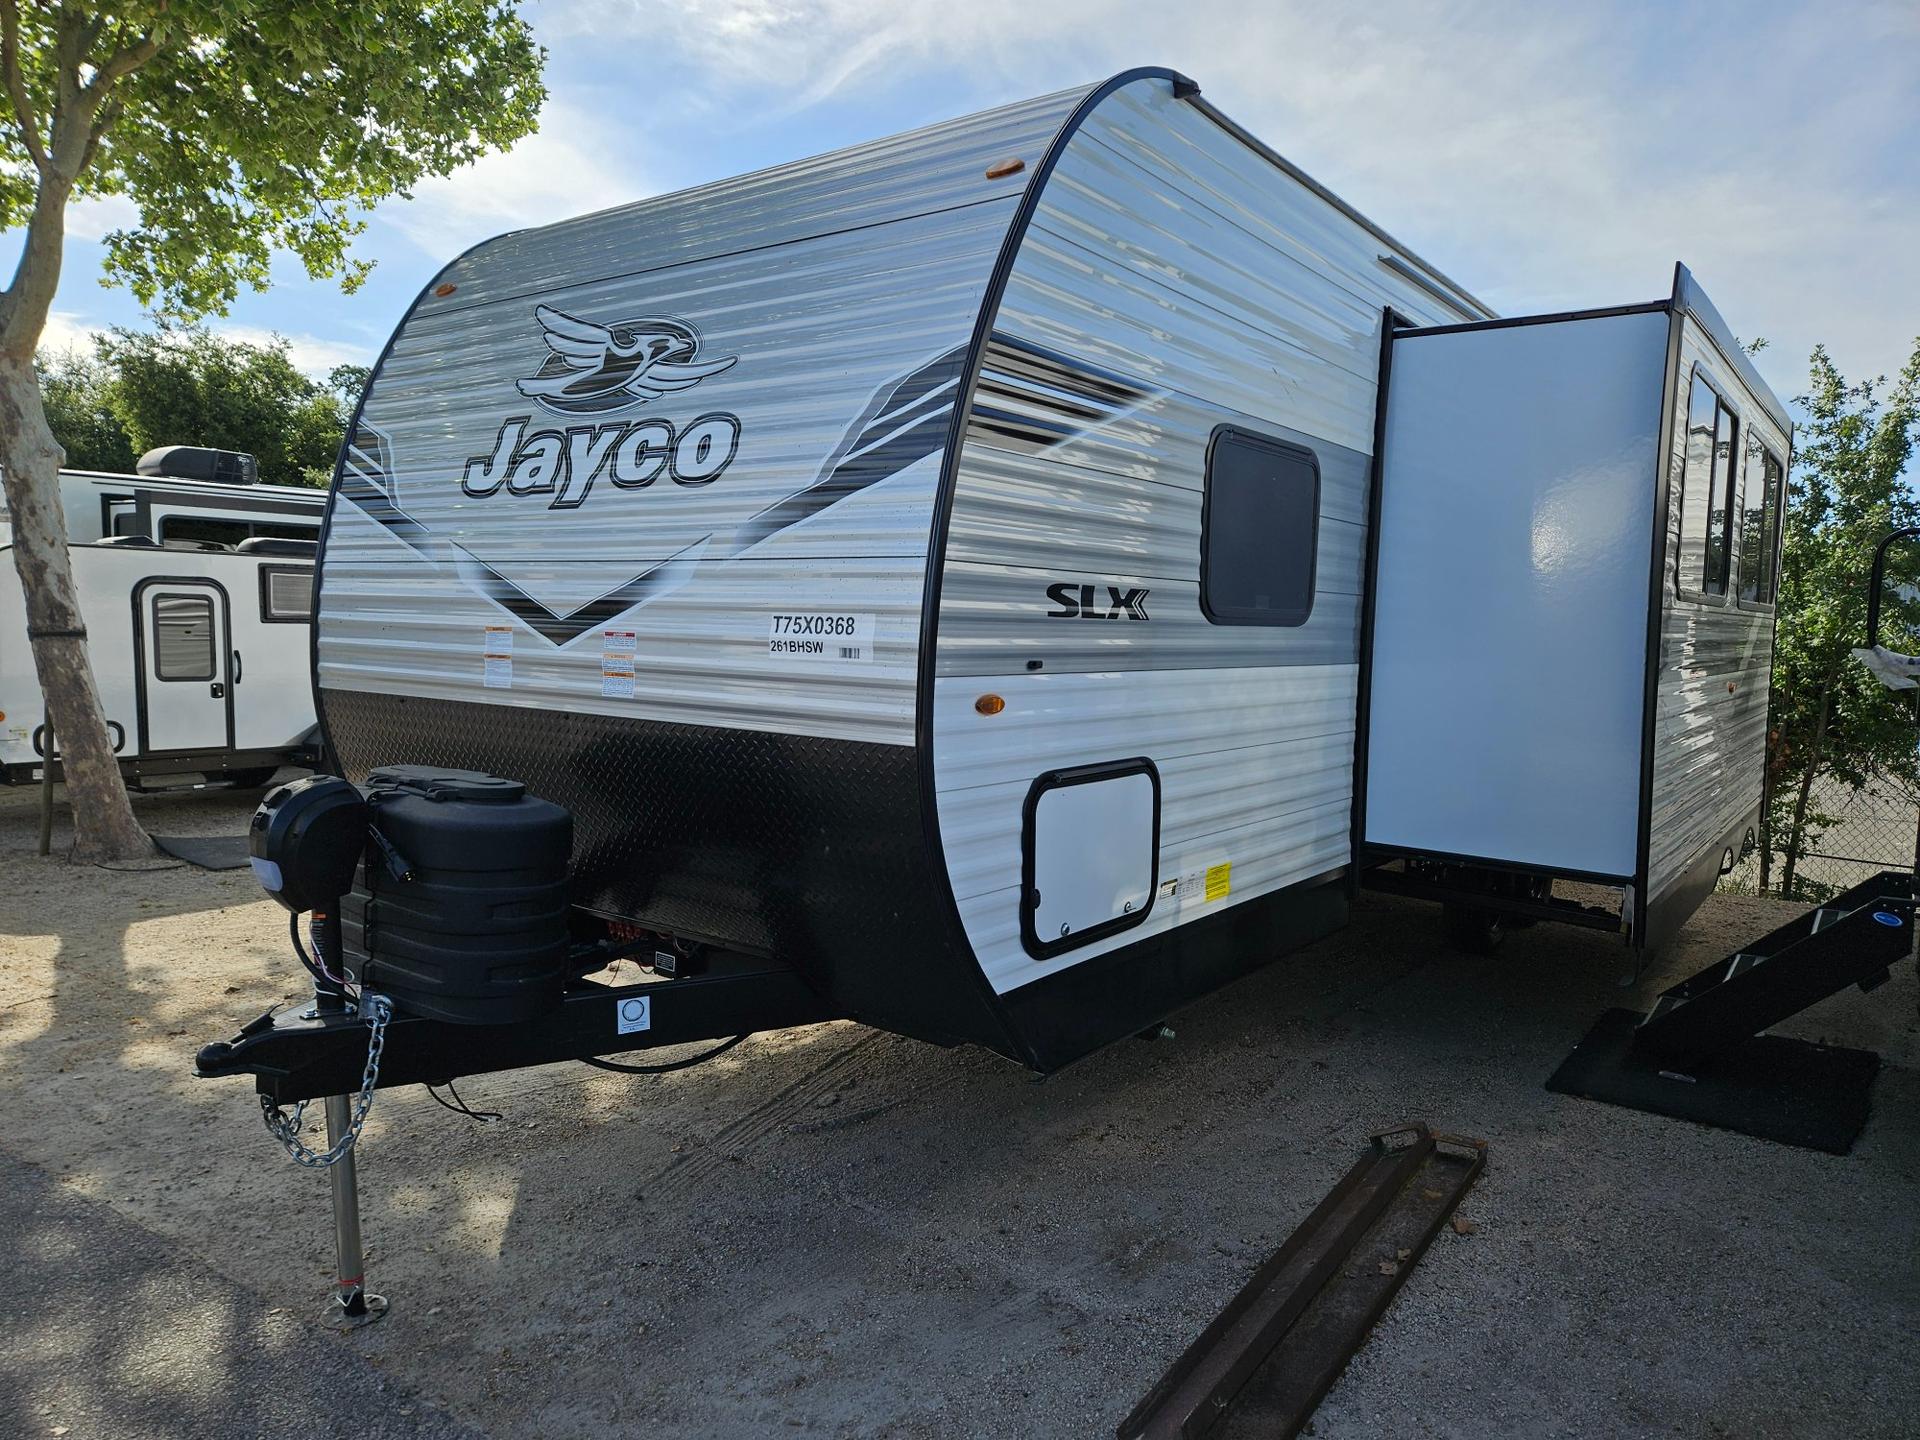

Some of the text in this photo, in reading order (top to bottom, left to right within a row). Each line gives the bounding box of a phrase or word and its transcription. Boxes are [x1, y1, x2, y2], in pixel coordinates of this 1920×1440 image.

[461, 411, 742, 510] Jayco
[1046, 583, 1150, 621] SLX
[773, 616, 855, 635] T75X0368
[771, 640, 824, 653] 261BHSW
